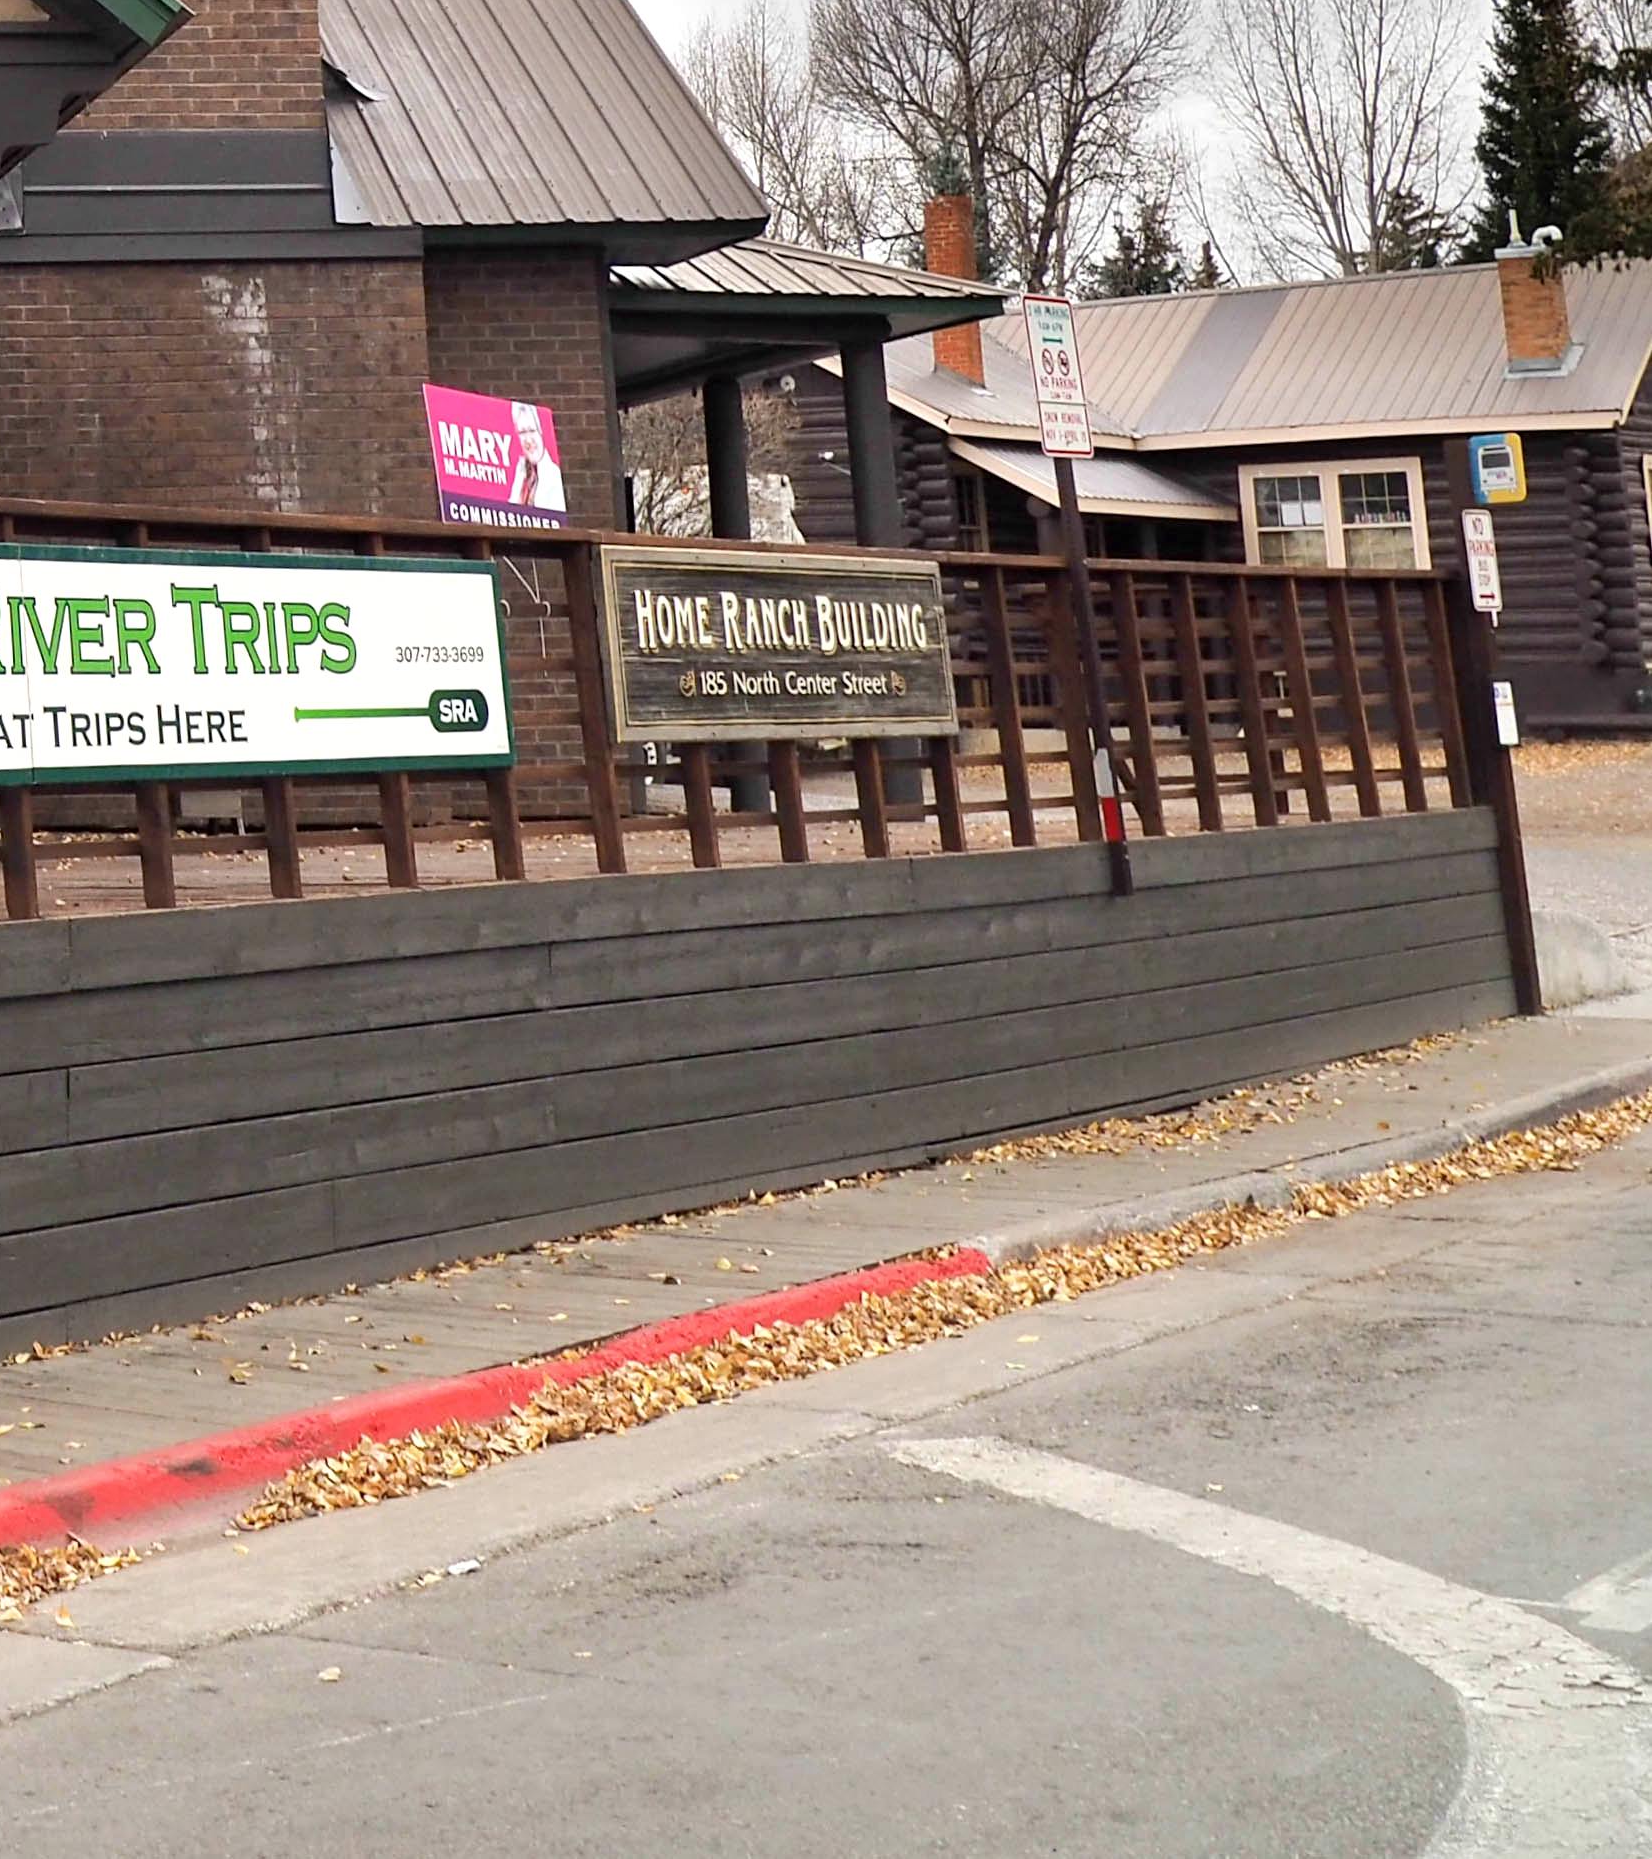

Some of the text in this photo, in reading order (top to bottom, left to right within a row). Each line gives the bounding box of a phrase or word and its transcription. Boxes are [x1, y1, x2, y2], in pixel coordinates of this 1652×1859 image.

[438, 421, 512, 467] MARY
[170, 583, 358, 675] TRIPS
[634, 589, 927, 653] HOME RANCH BUILDING
[700, 670, 888, 695] 185 North Center Street
[43, 705, 146, 748] TRIPS
[156, 704, 249, 744] HERE
[439, 698, 479, 723] SRA
